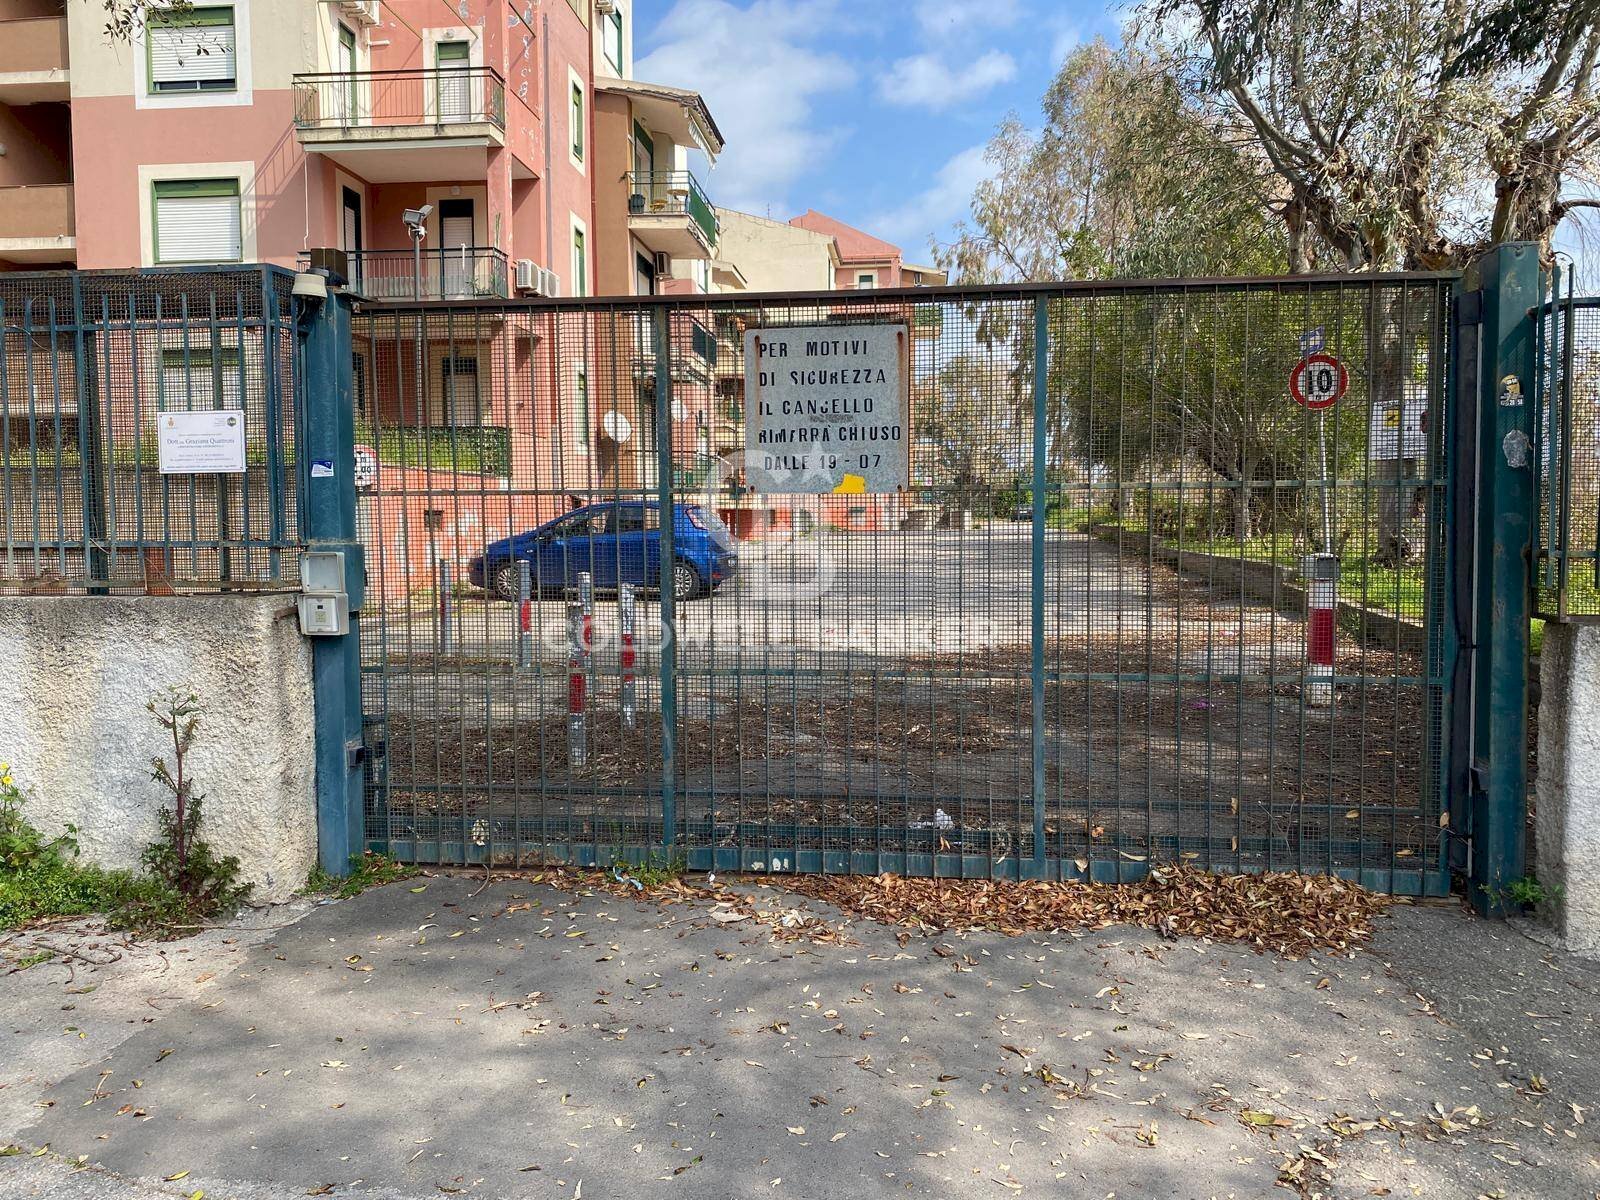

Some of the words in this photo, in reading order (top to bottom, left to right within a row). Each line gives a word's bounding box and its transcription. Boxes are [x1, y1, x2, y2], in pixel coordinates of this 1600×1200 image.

[759, 342, 788, 358] PER
[806, 340, 868, 357] MOTIVI
[759, 372, 775, 387] DI
[790, 369, 886, 386] SICUREZZA
[1305, 368, 1332, 394] 10
[759, 401, 773, 416] IL
[782, 398, 874, 415] CANCELLO
[838, 425, 901, 442] CHIUSO
[764, 455, 810, 471] DALLE
[820, 454, 837, 470] 19
[859, 454, 881, 469] 07
